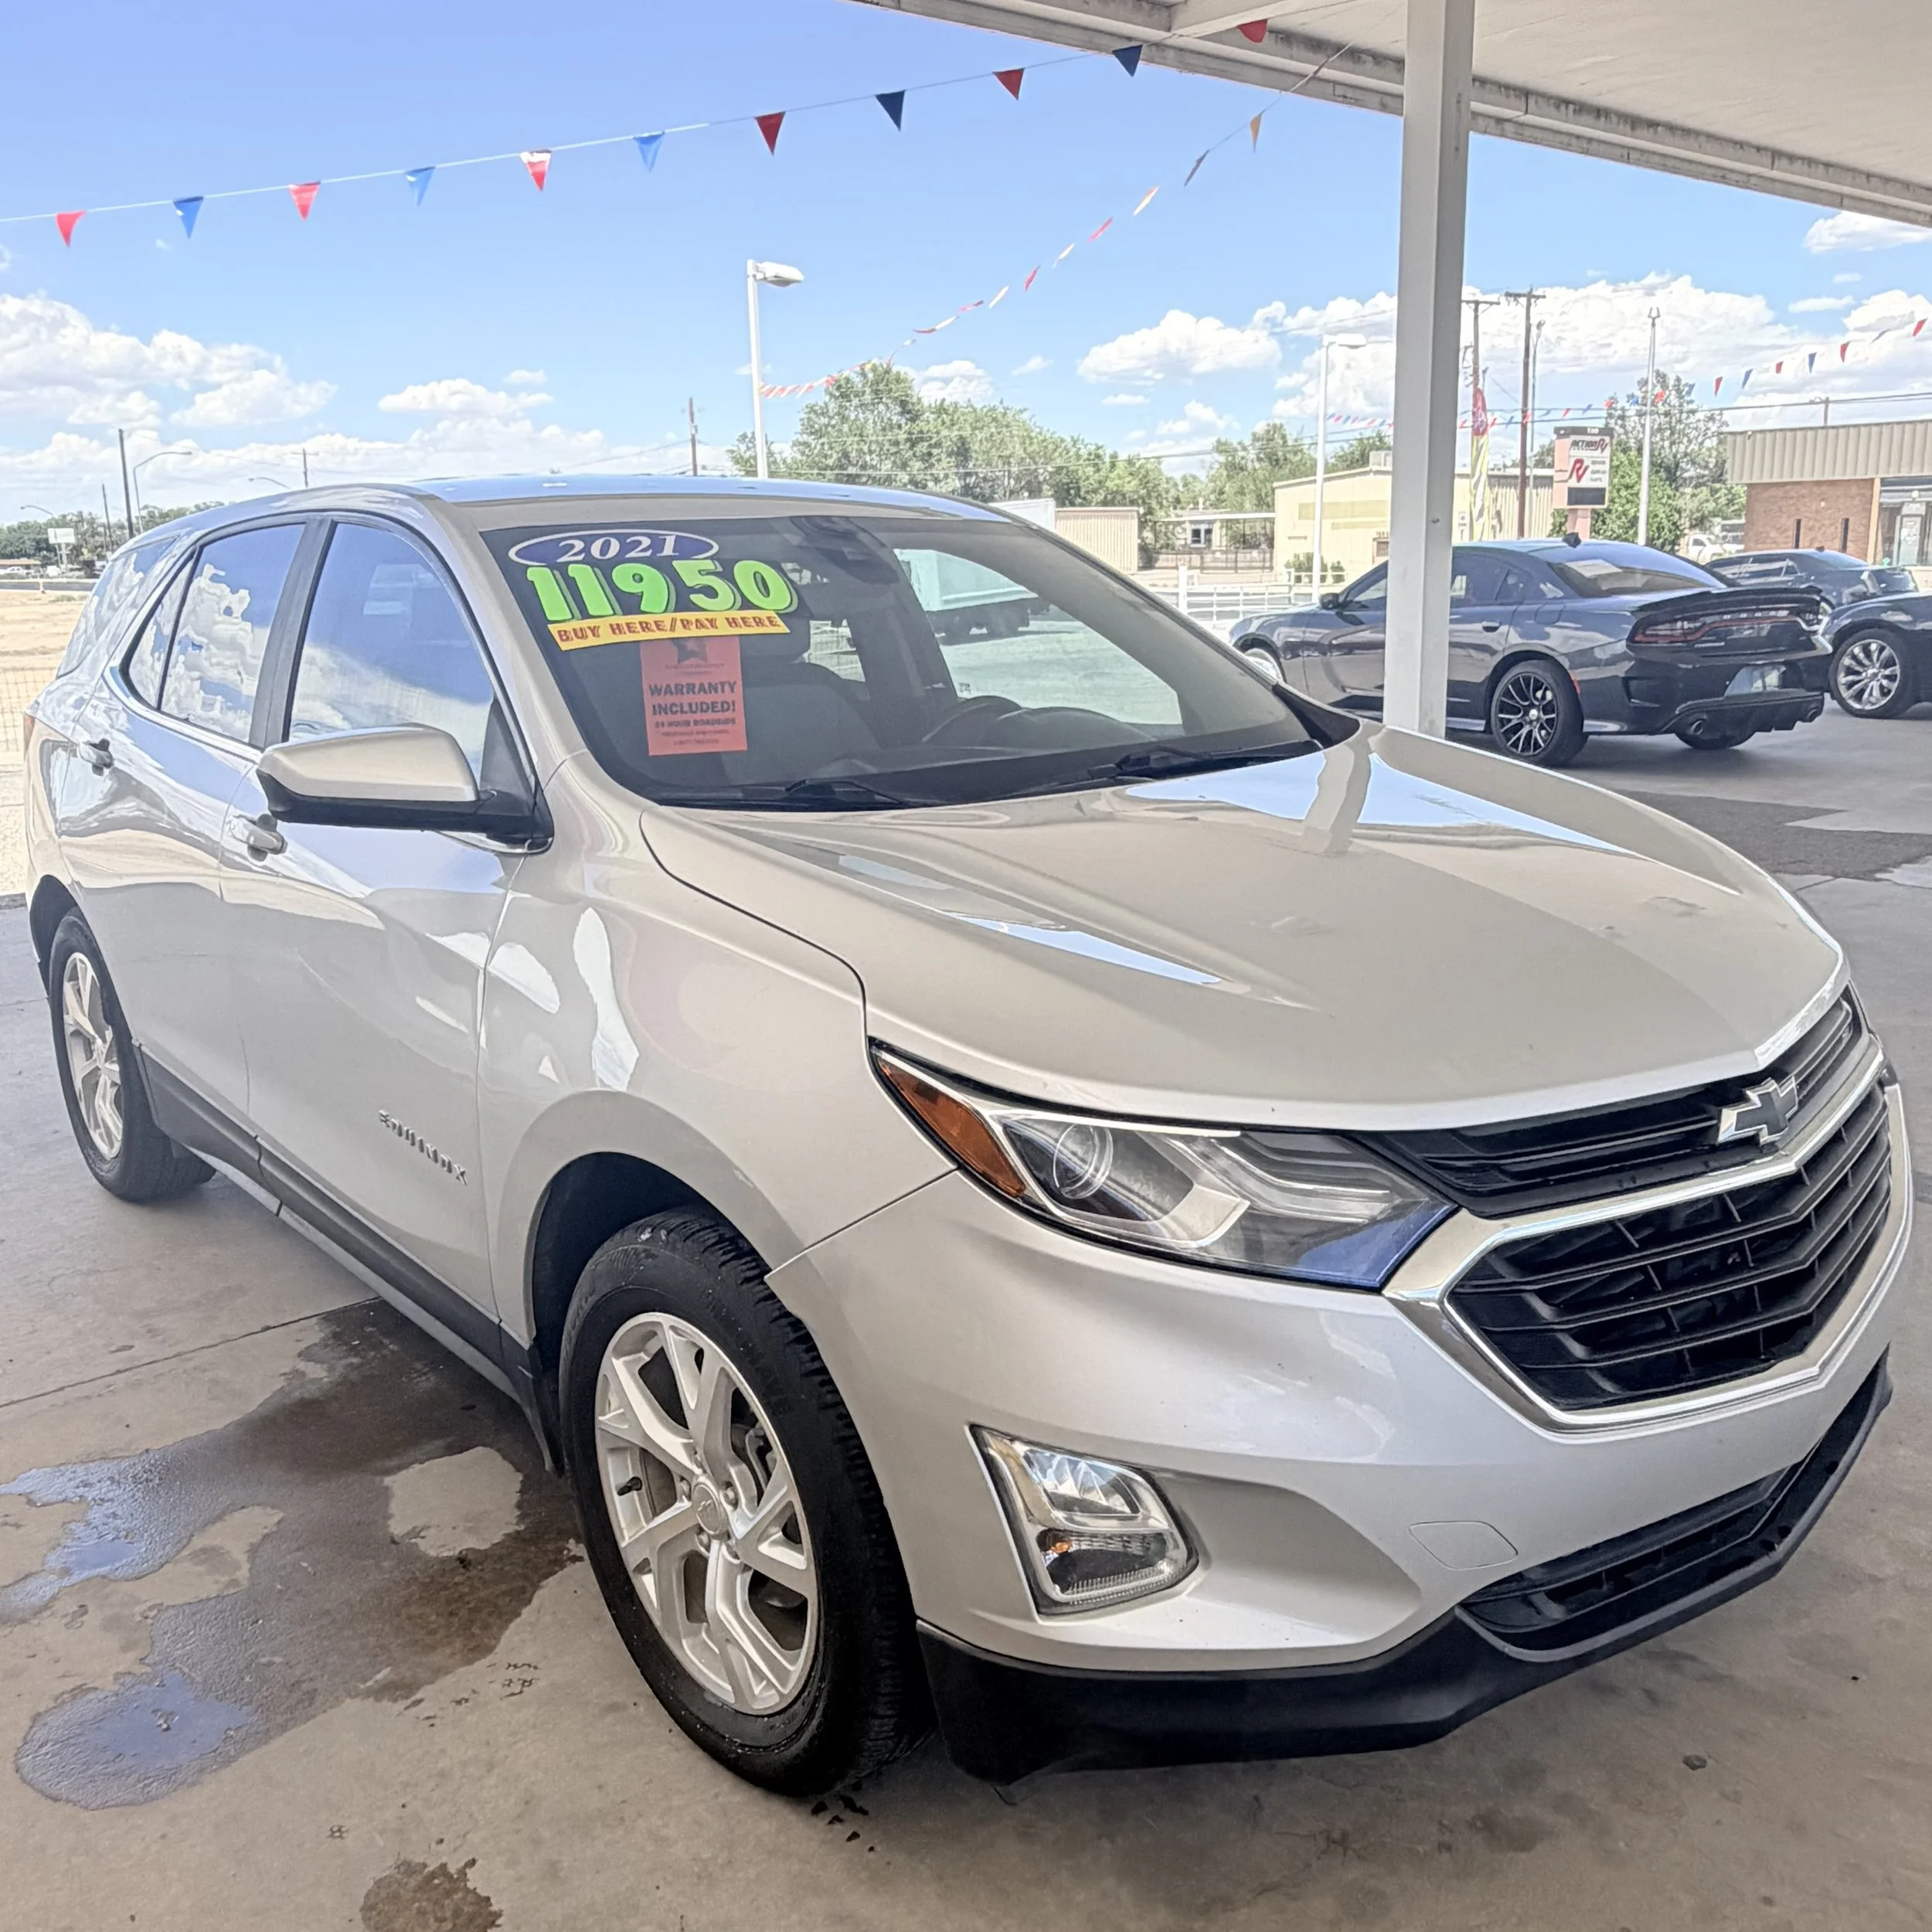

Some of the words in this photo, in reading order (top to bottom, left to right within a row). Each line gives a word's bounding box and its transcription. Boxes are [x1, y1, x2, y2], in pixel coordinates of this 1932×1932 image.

[556, 535, 679, 563] 2021
[527, 560, 798, 621] 11950
[557, 624, 601, 644] BUY
[725, 615, 781, 629] HERE
[649, 681, 736, 696] WARRANTY
[652, 699, 736, 716] INCLUDED!
[379, 1109, 467, 1185] EQUINOX
